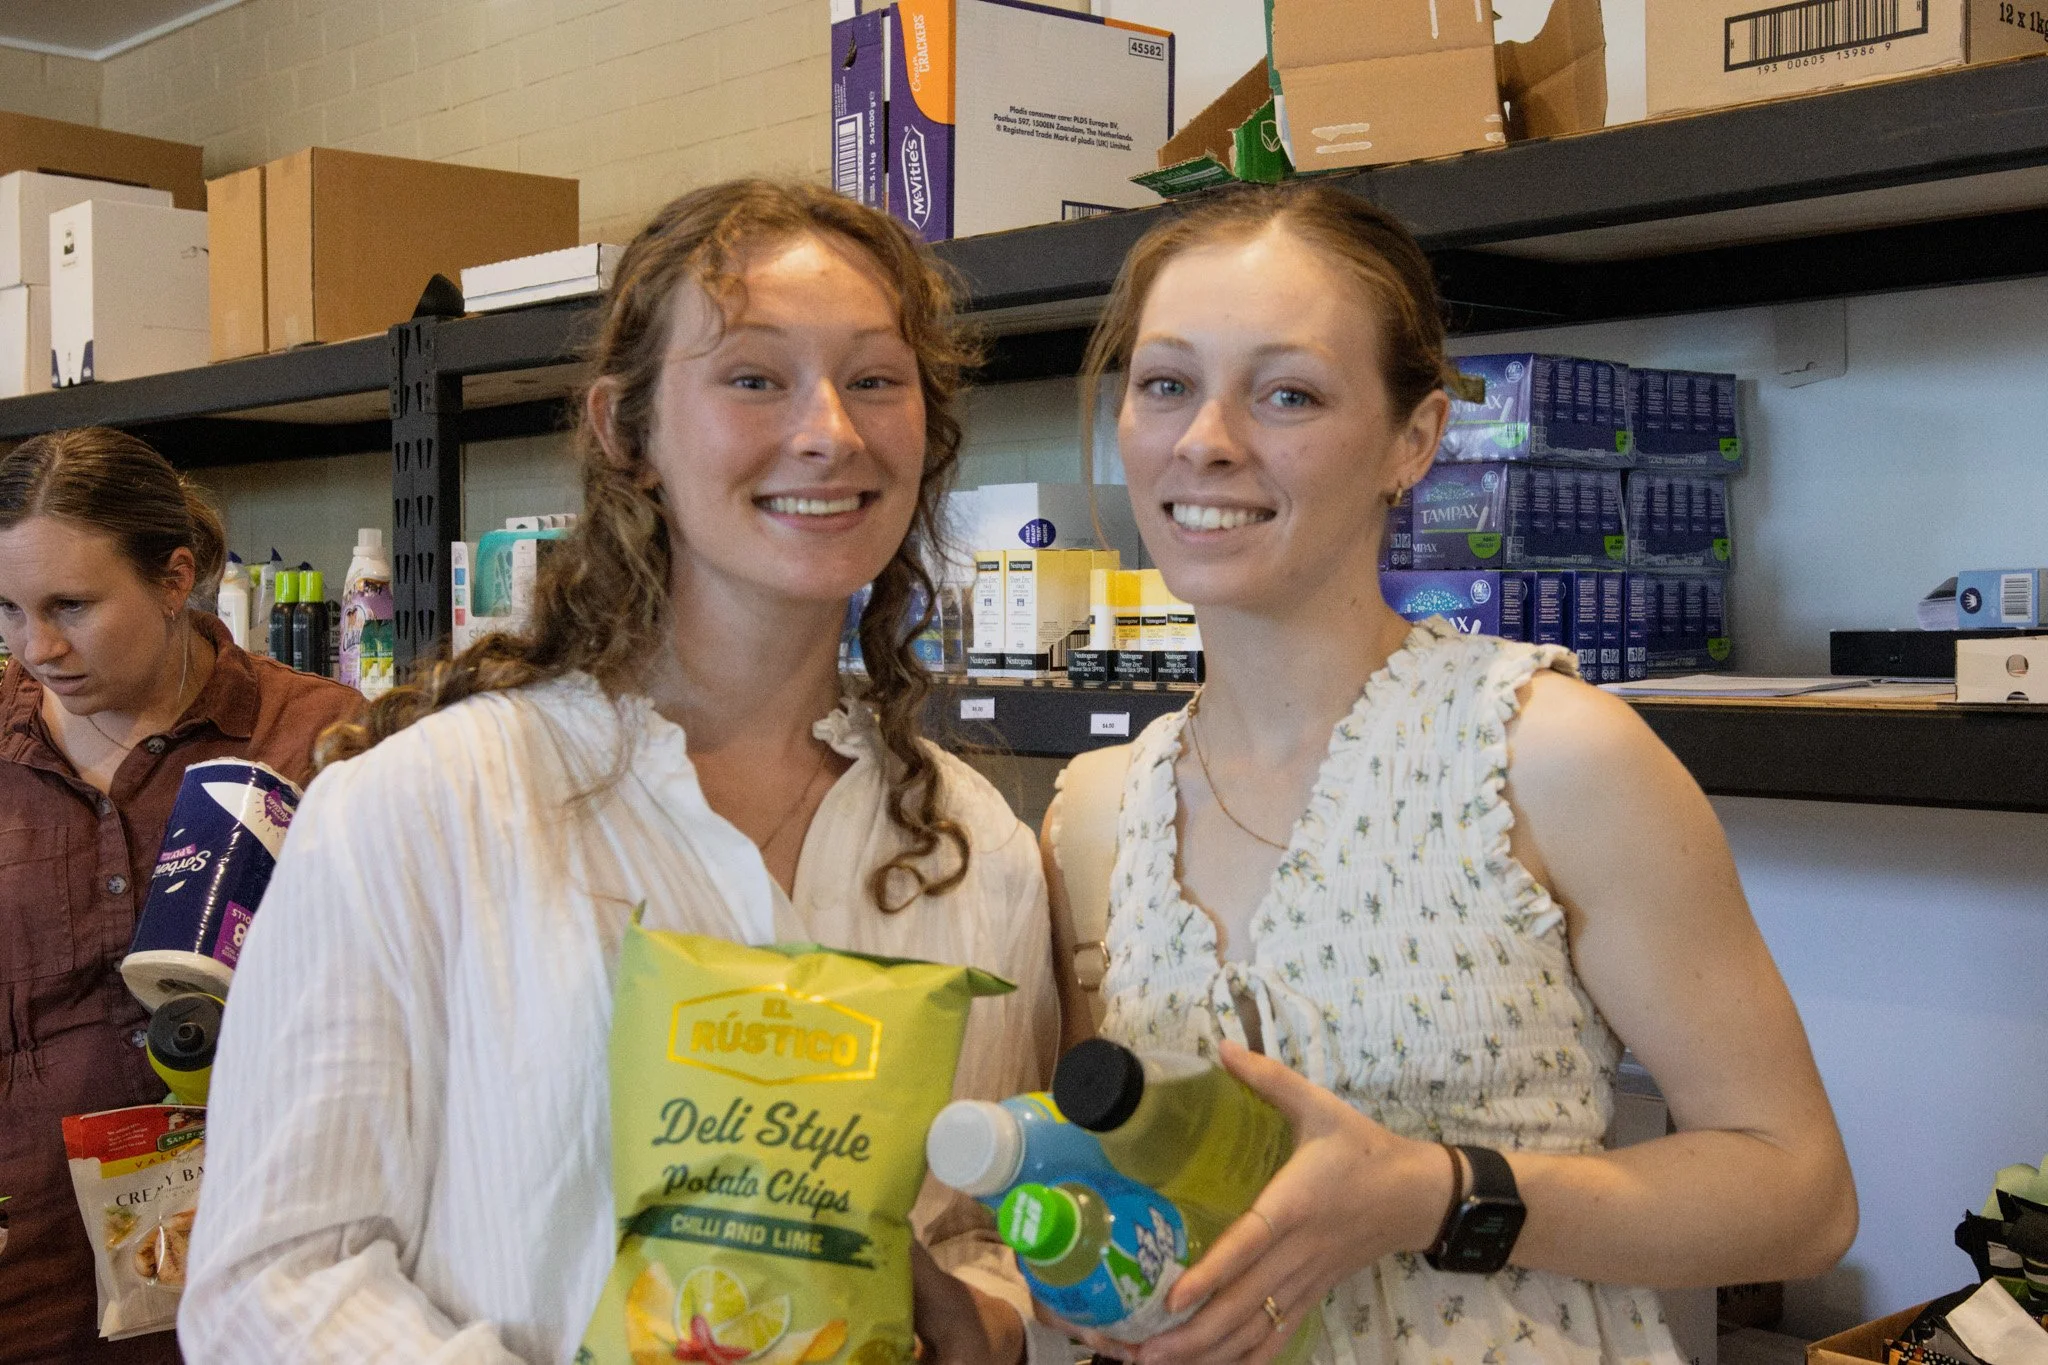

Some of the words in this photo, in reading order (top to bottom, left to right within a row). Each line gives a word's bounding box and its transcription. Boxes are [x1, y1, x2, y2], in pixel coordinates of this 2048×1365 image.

[2000, 2, 2014, 25] 12
[2017, 11, 2026, 28] x
[912, 14, 929, 73] CRACKERS
[1131, 42, 1162, 56] 45582
[1756, 63, 1778, 76] 193
[1787, 56, 1826, 70] 00605
[1836, 44, 1875, 61] 13986
[1884, 42, 1892, 51] 9
[994, 113, 1017, 124] Postbus
[1018, 118, 1031, 126] 597,
[1032, 120, 1055, 130] 1500EN
[1056, 123, 1085, 134] Zaandam,
[1086, 128, 1097, 136] The
[1098, 130, 1133, 142] Netherlands.
[1010, 106, 1028, 116] Pladis
[1028, 110, 1056, 120] consumer
[1074, 116, 1088, 124] PLDS
[1089, 118, 1109, 128] Europe
[1003, 125, 1034, 136] Registered
[1036, 130, 1052, 139] Trade
[1054, 133, 1068, 141] Mark
[1078, 138, 1095, 146] pladis
[1096, 140, 1108, 148] (UK)
[1110, 142, 1131, 151] Limited.
[870, 152, 876, 165] kg
[908, 138, 926, 216] McVitie's
[1420, 504, 1478, 524] TAMPAX
[1412, 543, 1438, 552] MPAX
[970, 656, 997, 666] Neutrogena
[1006, 656, 1032, 667] Neutrogena
[1074, 652, 1098, 660] Neutrogena
[1120, 653, 1143, 661] Neutrogena
[1164, 653, 1188, 661] Neutrogena
[232, 908, 252, 924] OLLS
[762, 998, 793, 1020] EL
[690, 1009, 858, 1068] RÚSTICO
[166, 1135, 186, 1146] SAN
[186, 1130, 205, 1138] REM
[651, 1096, 753, 1147] Deli
[756, 1101, 870, 1172] Style
[116, 1172, 174, 1207] CREY
[182, 1166, 204, 1182] BA
[662, 1164, 760, 1198] Potato
[766, 1168, 850, 1219] Chips
[670, 1212, 721, 1237] CHILLI
[722, 1220, 768, 1245] AND
[772, 1228, 824, 1254] LIME
